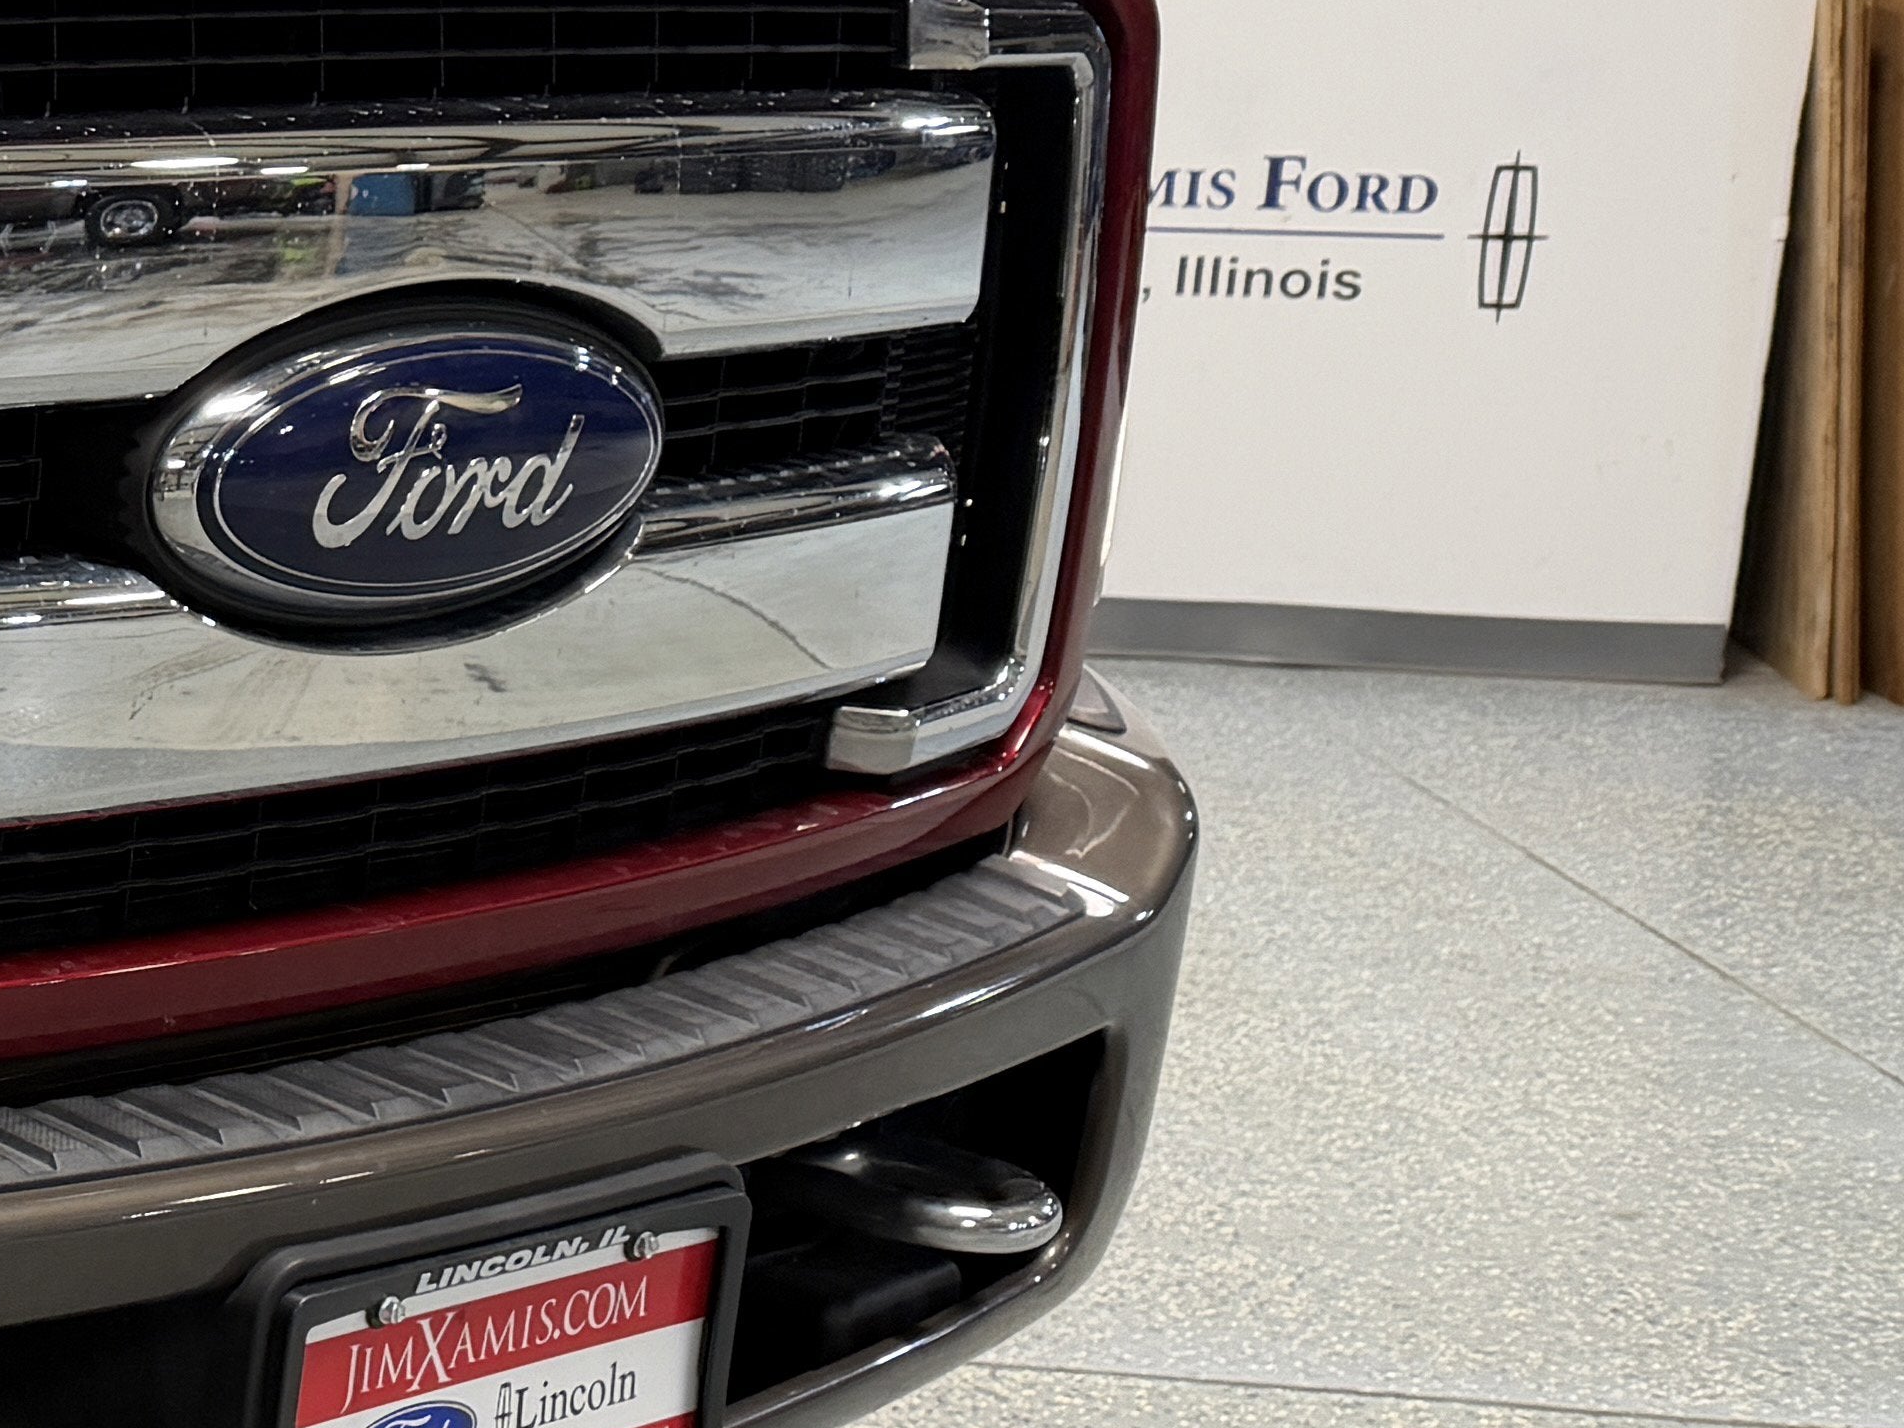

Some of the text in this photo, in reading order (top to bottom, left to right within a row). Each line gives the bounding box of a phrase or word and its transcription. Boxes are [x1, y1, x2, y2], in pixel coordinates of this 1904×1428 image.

[1256, 154, 1439, 215] FORD
[1175, 255, 1363, 300] Illinois
[312, 383, 586, 549] Ford
[415, 1225, 631, 1294] LINCOLN, IL
